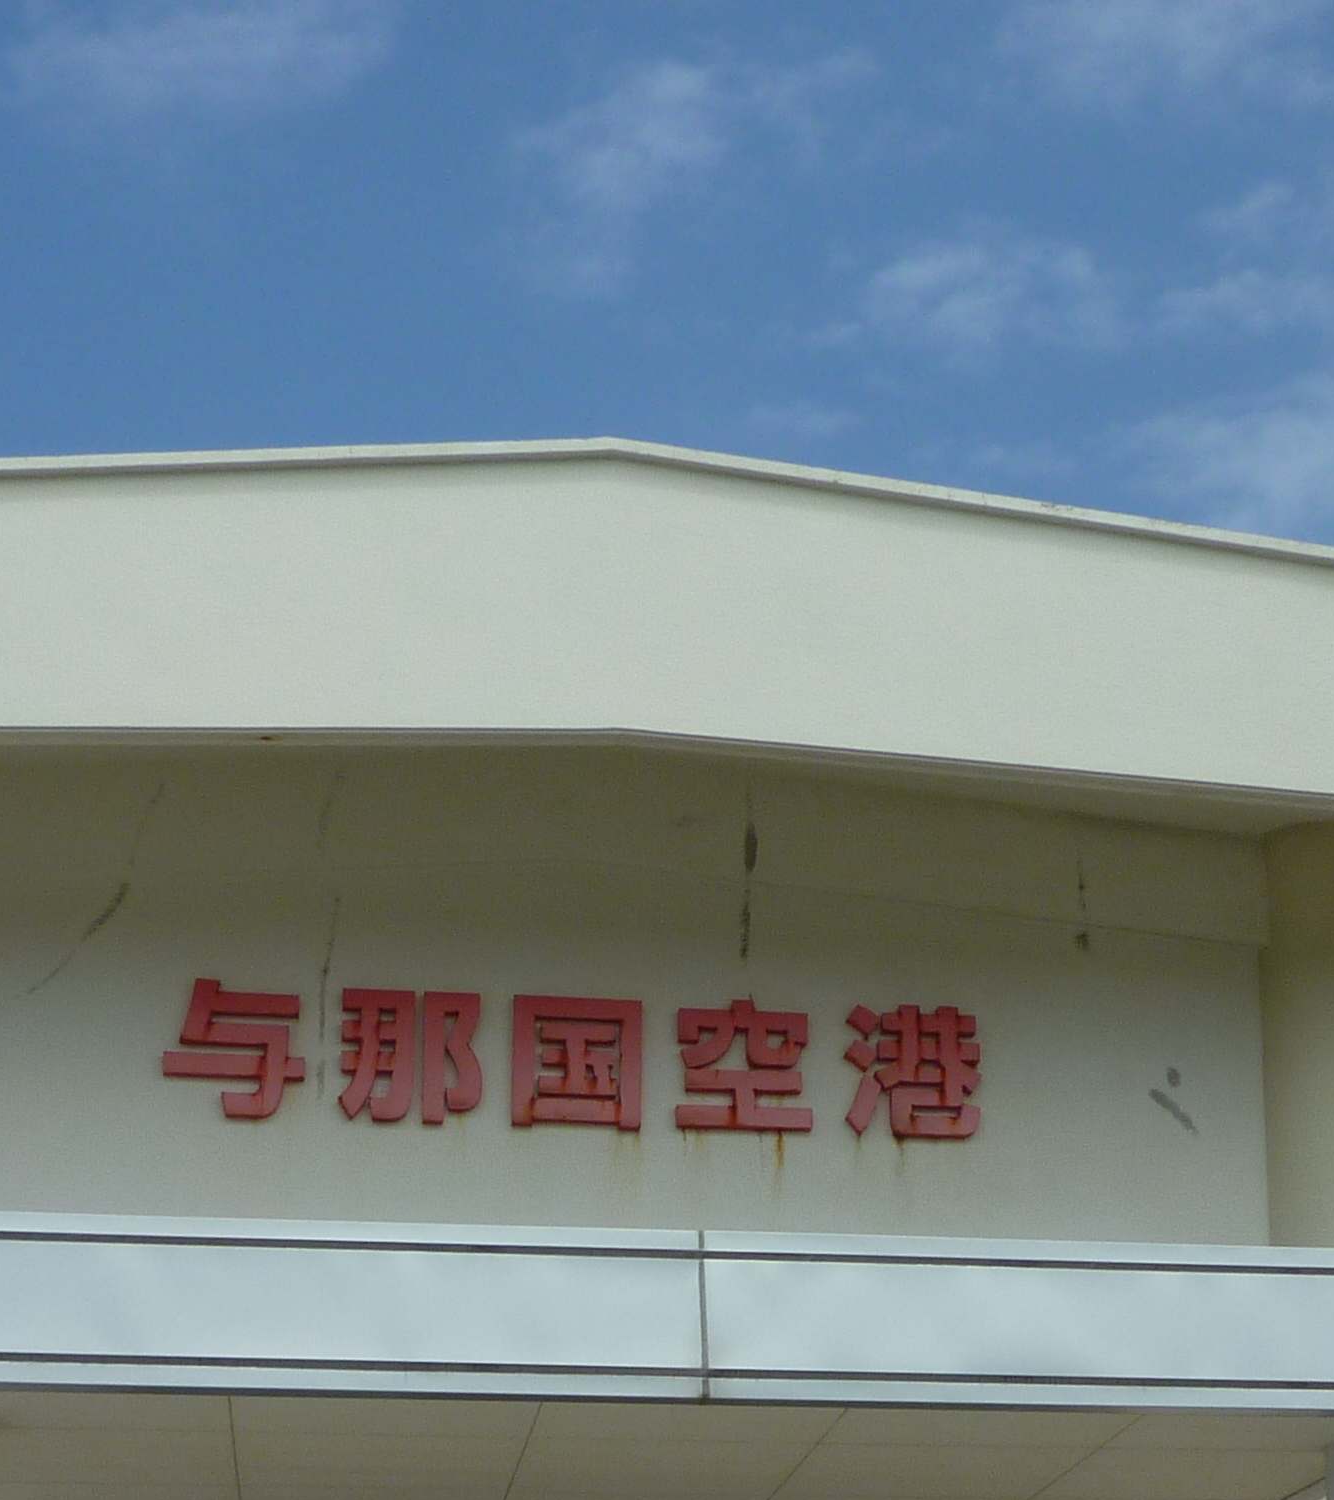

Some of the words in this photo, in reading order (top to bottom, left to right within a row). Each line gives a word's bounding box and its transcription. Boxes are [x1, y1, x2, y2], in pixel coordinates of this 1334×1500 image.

[162, 977, 982, 1139] 与那国空港
